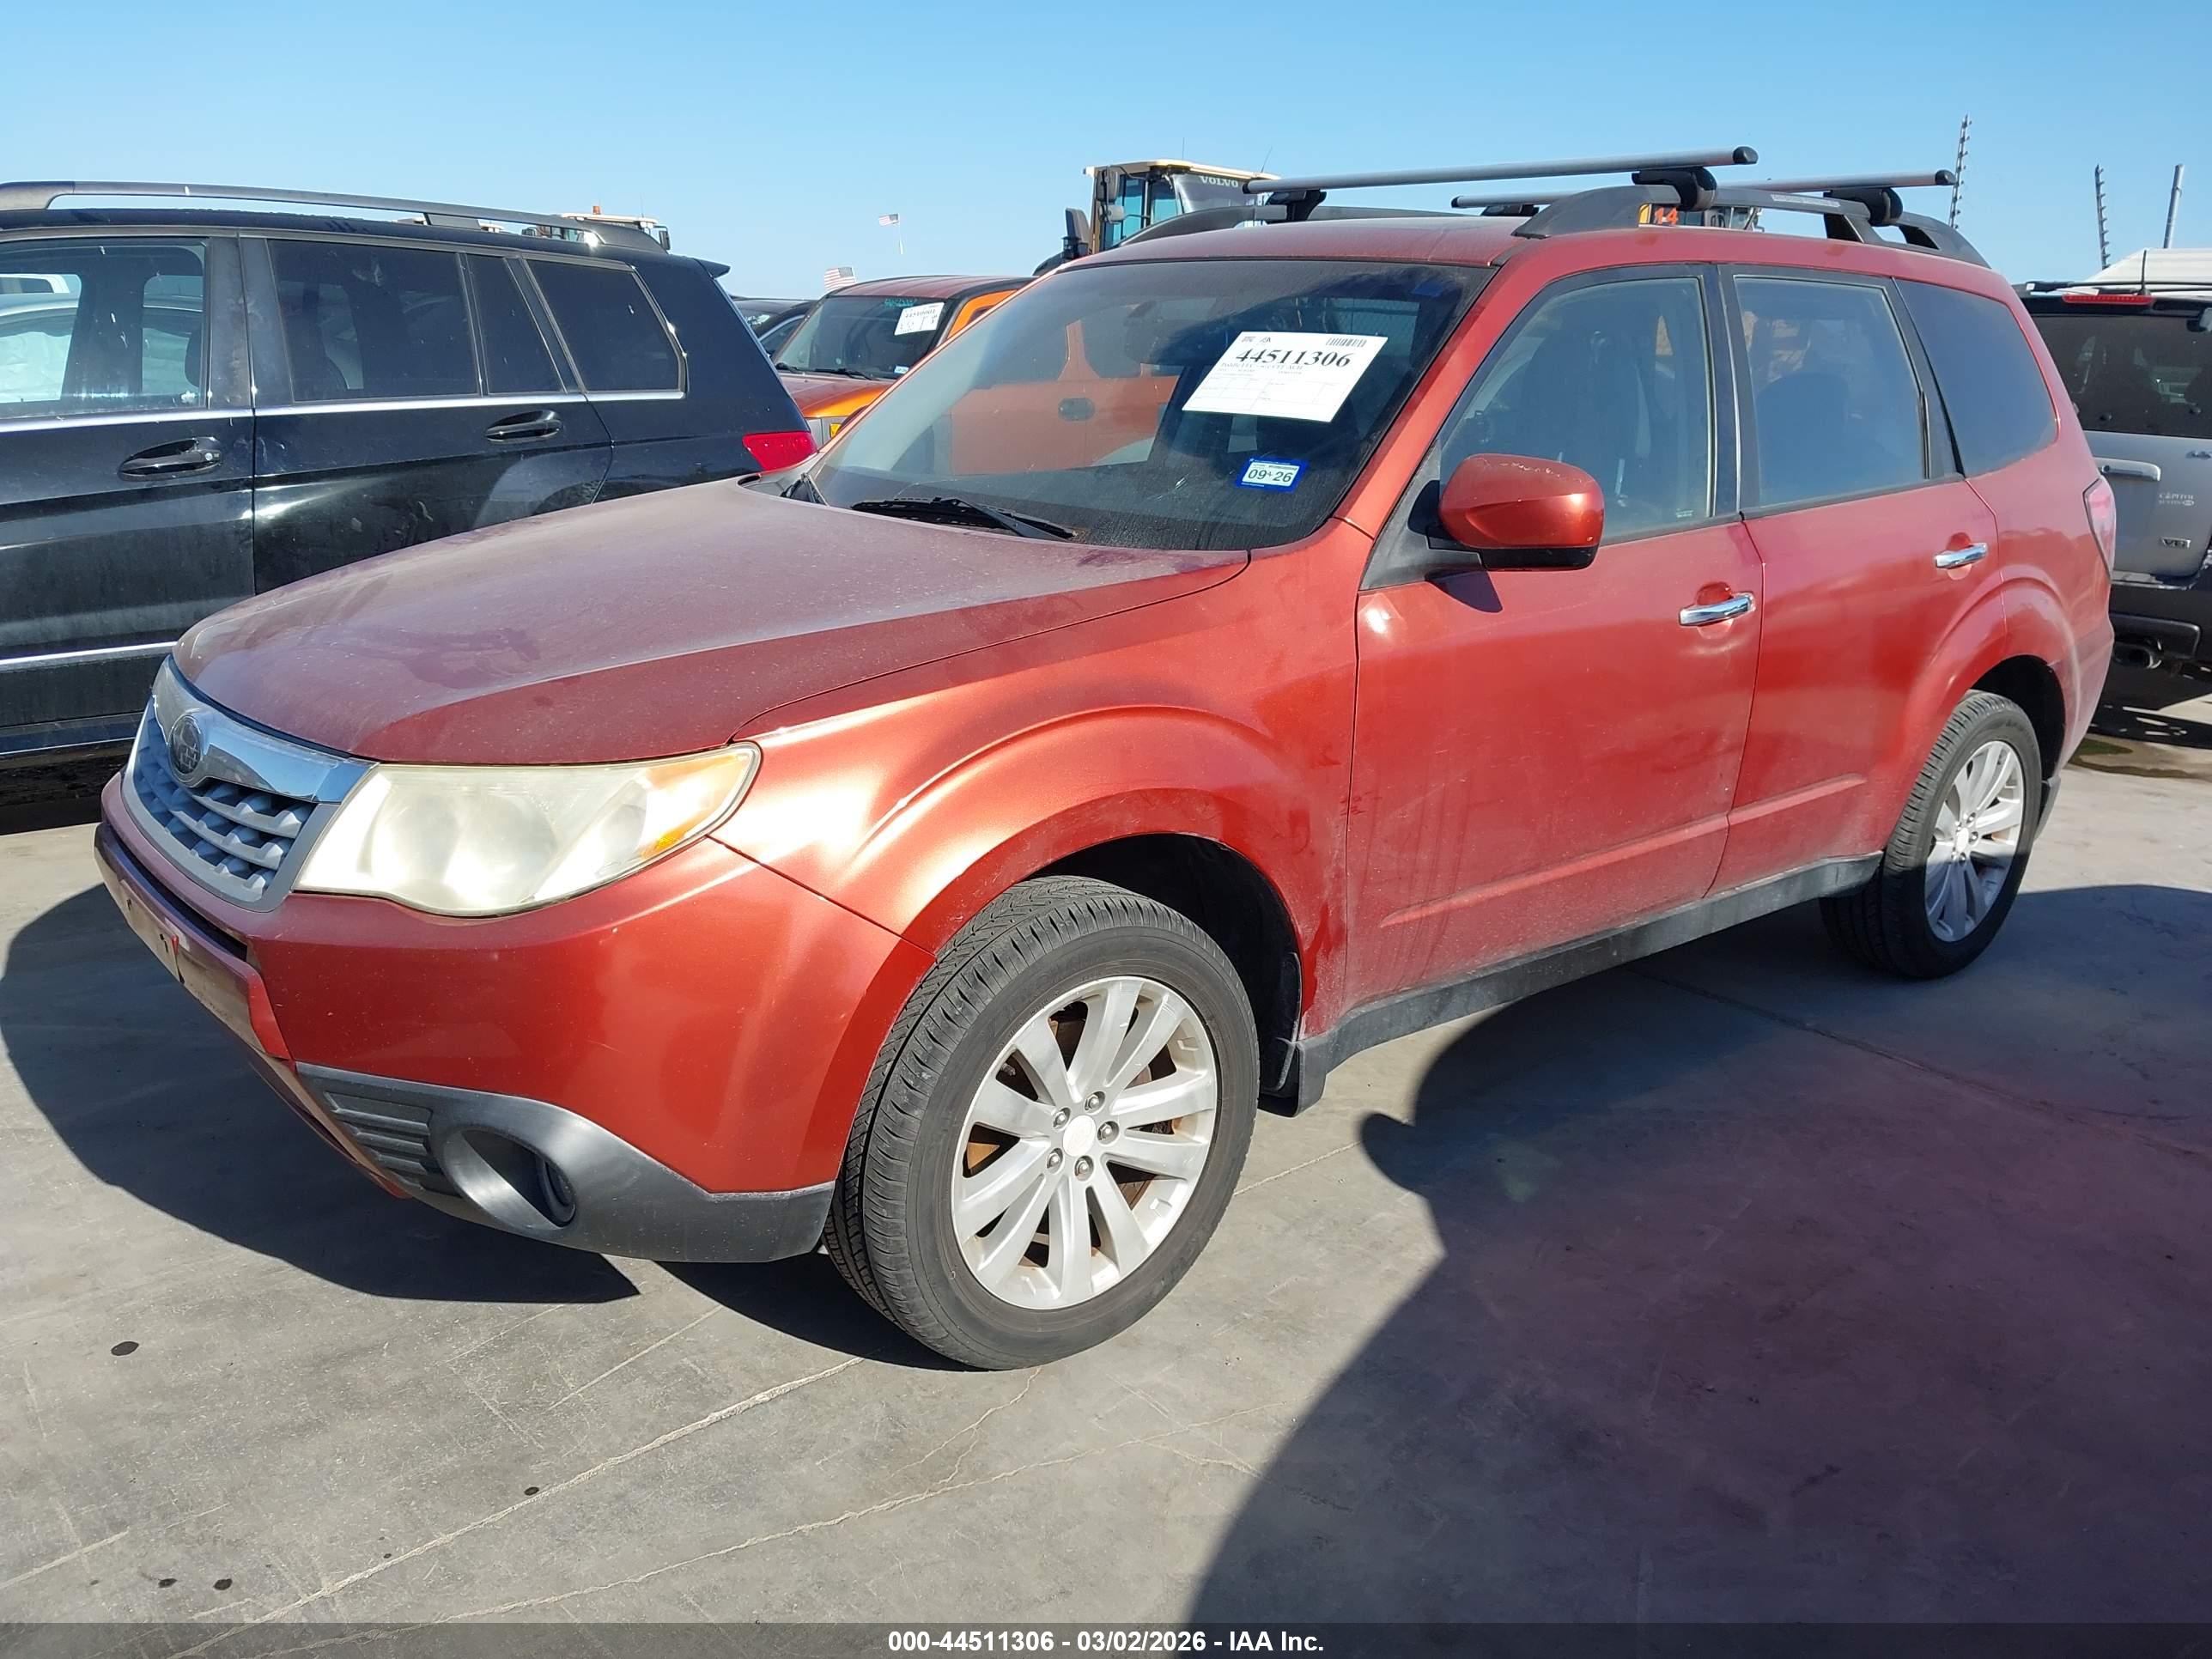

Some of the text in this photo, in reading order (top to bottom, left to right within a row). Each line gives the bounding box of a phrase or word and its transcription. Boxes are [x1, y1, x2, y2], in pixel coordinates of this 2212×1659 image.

[1199, 175, 1239, 188] VOLVO
[1236, 348, 1354, 368] 44511306
[1248, 469, 1294, 483] 09 26
